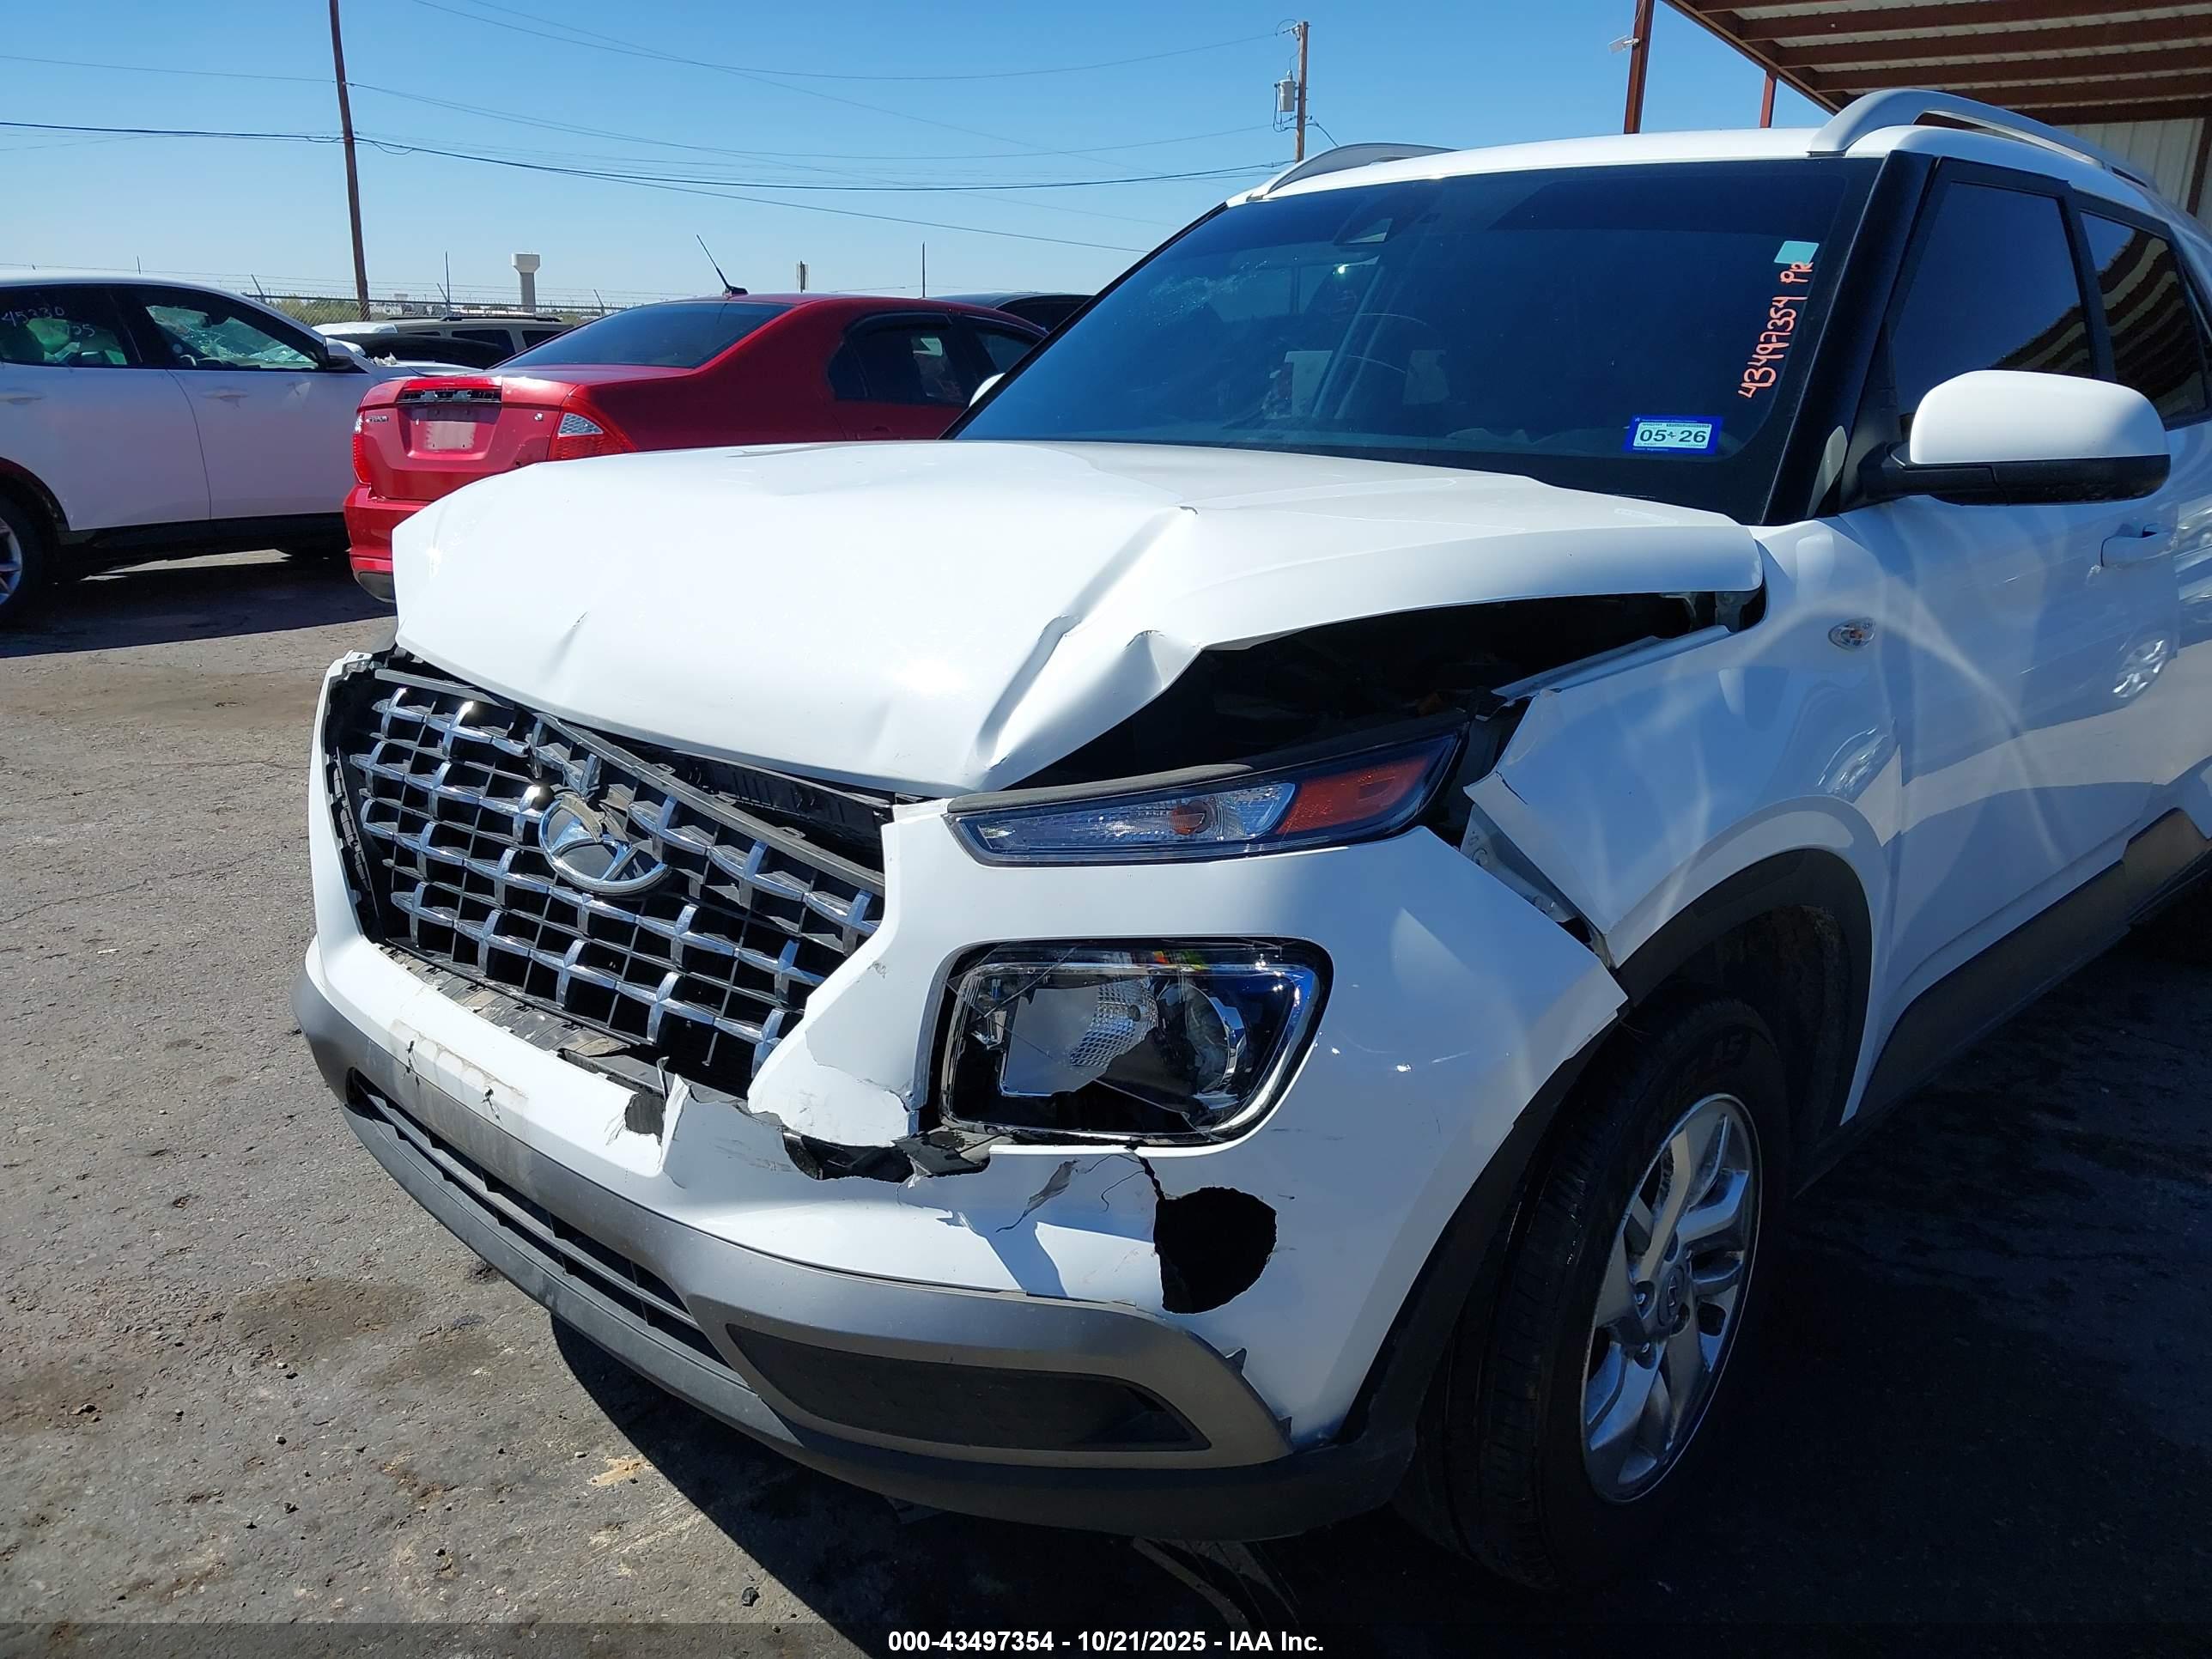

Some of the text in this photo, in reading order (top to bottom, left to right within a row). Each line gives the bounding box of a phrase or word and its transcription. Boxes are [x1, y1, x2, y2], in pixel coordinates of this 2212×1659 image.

[1737, 261, 1814, 398] 43497354 PR
[1639, 429, 1707, 443] 05 26
